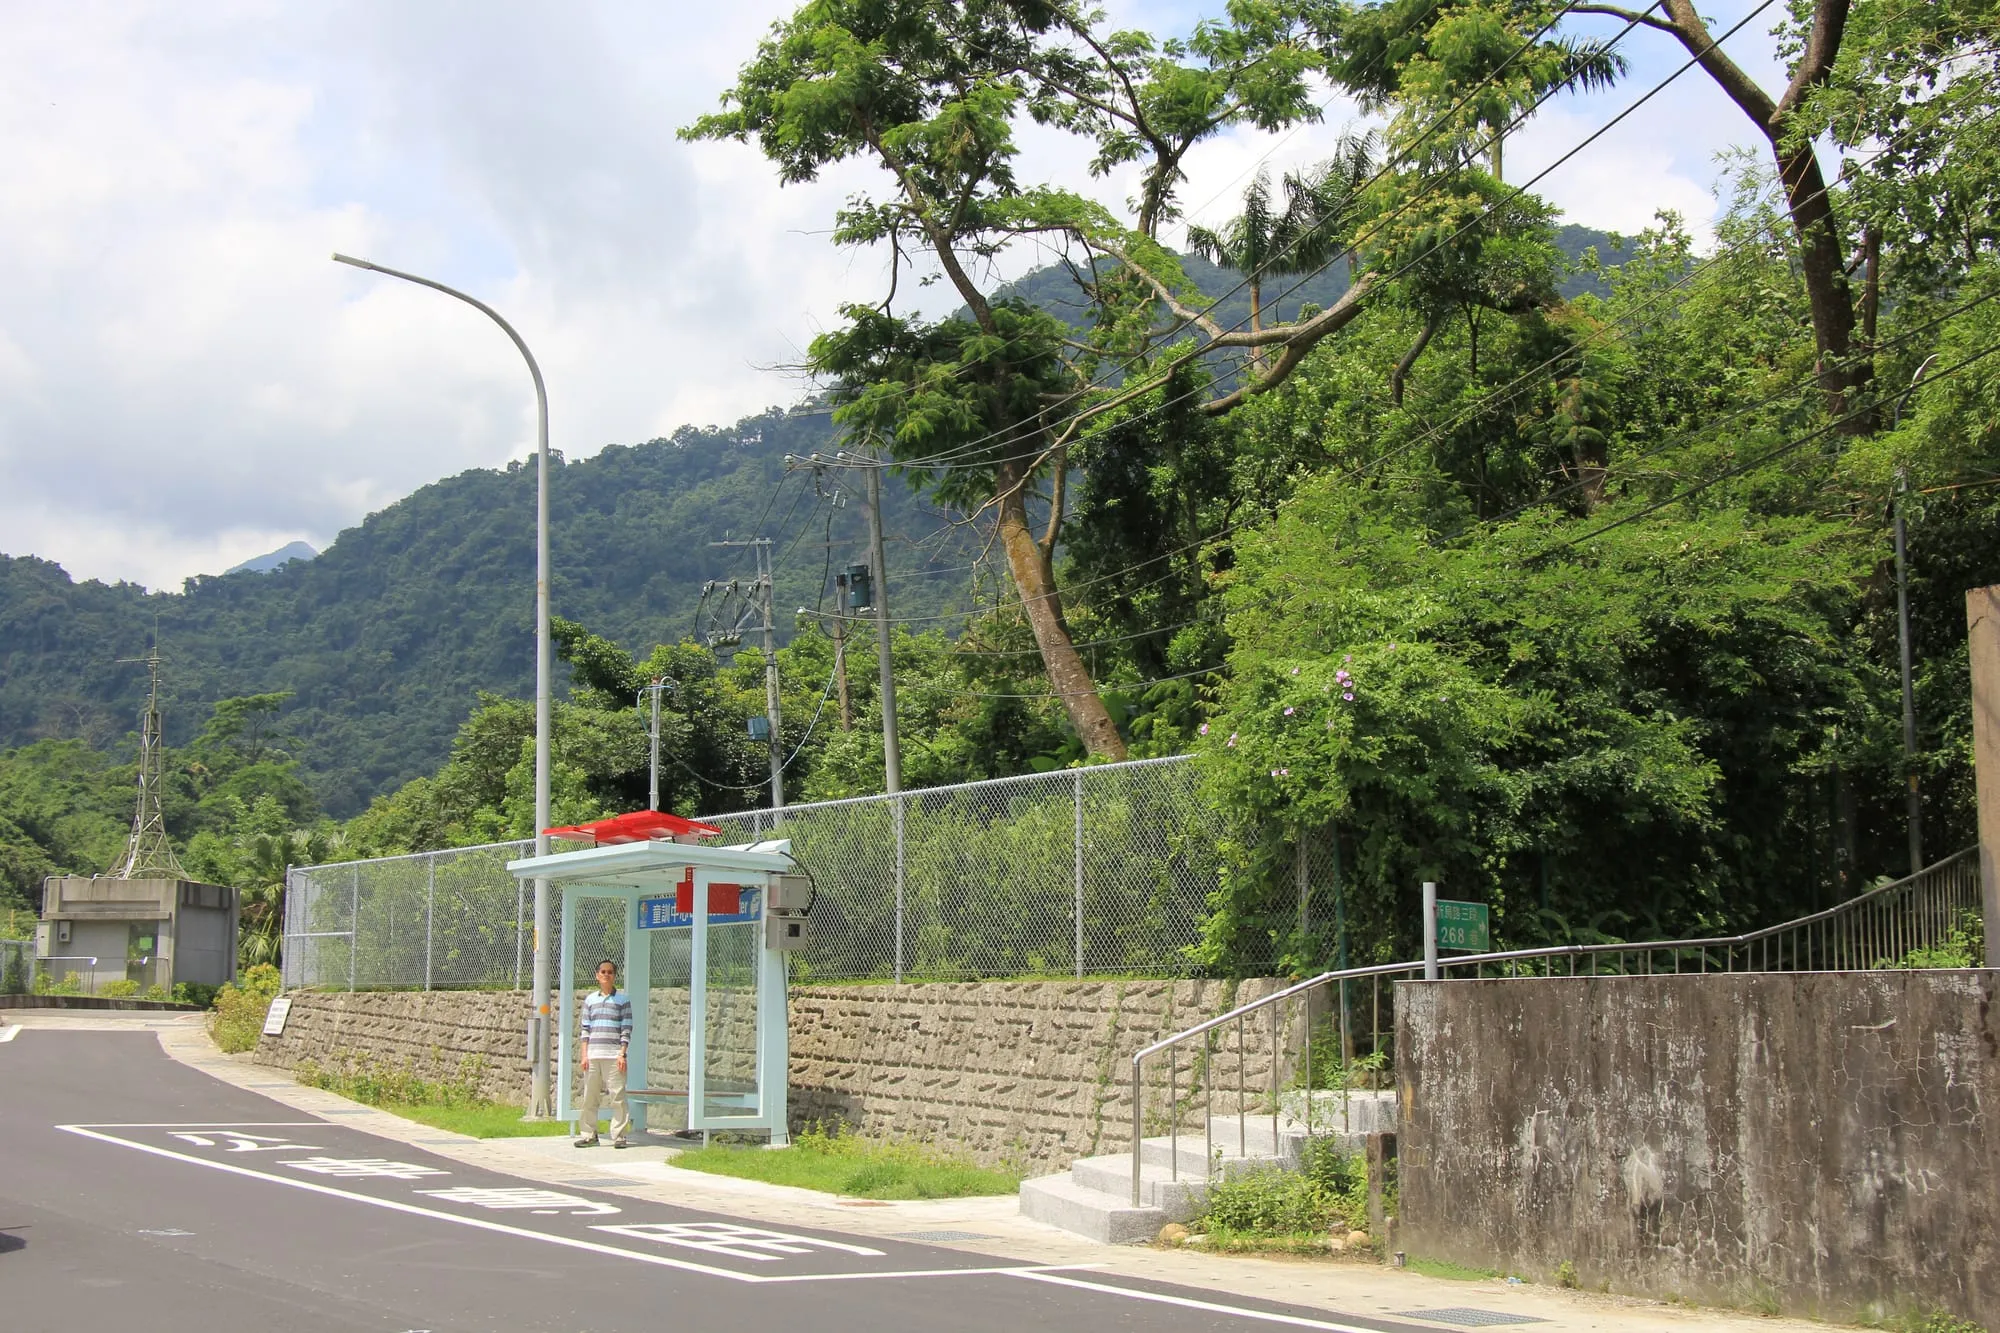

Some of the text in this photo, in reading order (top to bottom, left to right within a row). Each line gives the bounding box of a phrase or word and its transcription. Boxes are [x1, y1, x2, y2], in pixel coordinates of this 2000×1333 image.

[1441, 927, 1465, 944] 268
[166, 1130, 887, 1260] 公車專用
